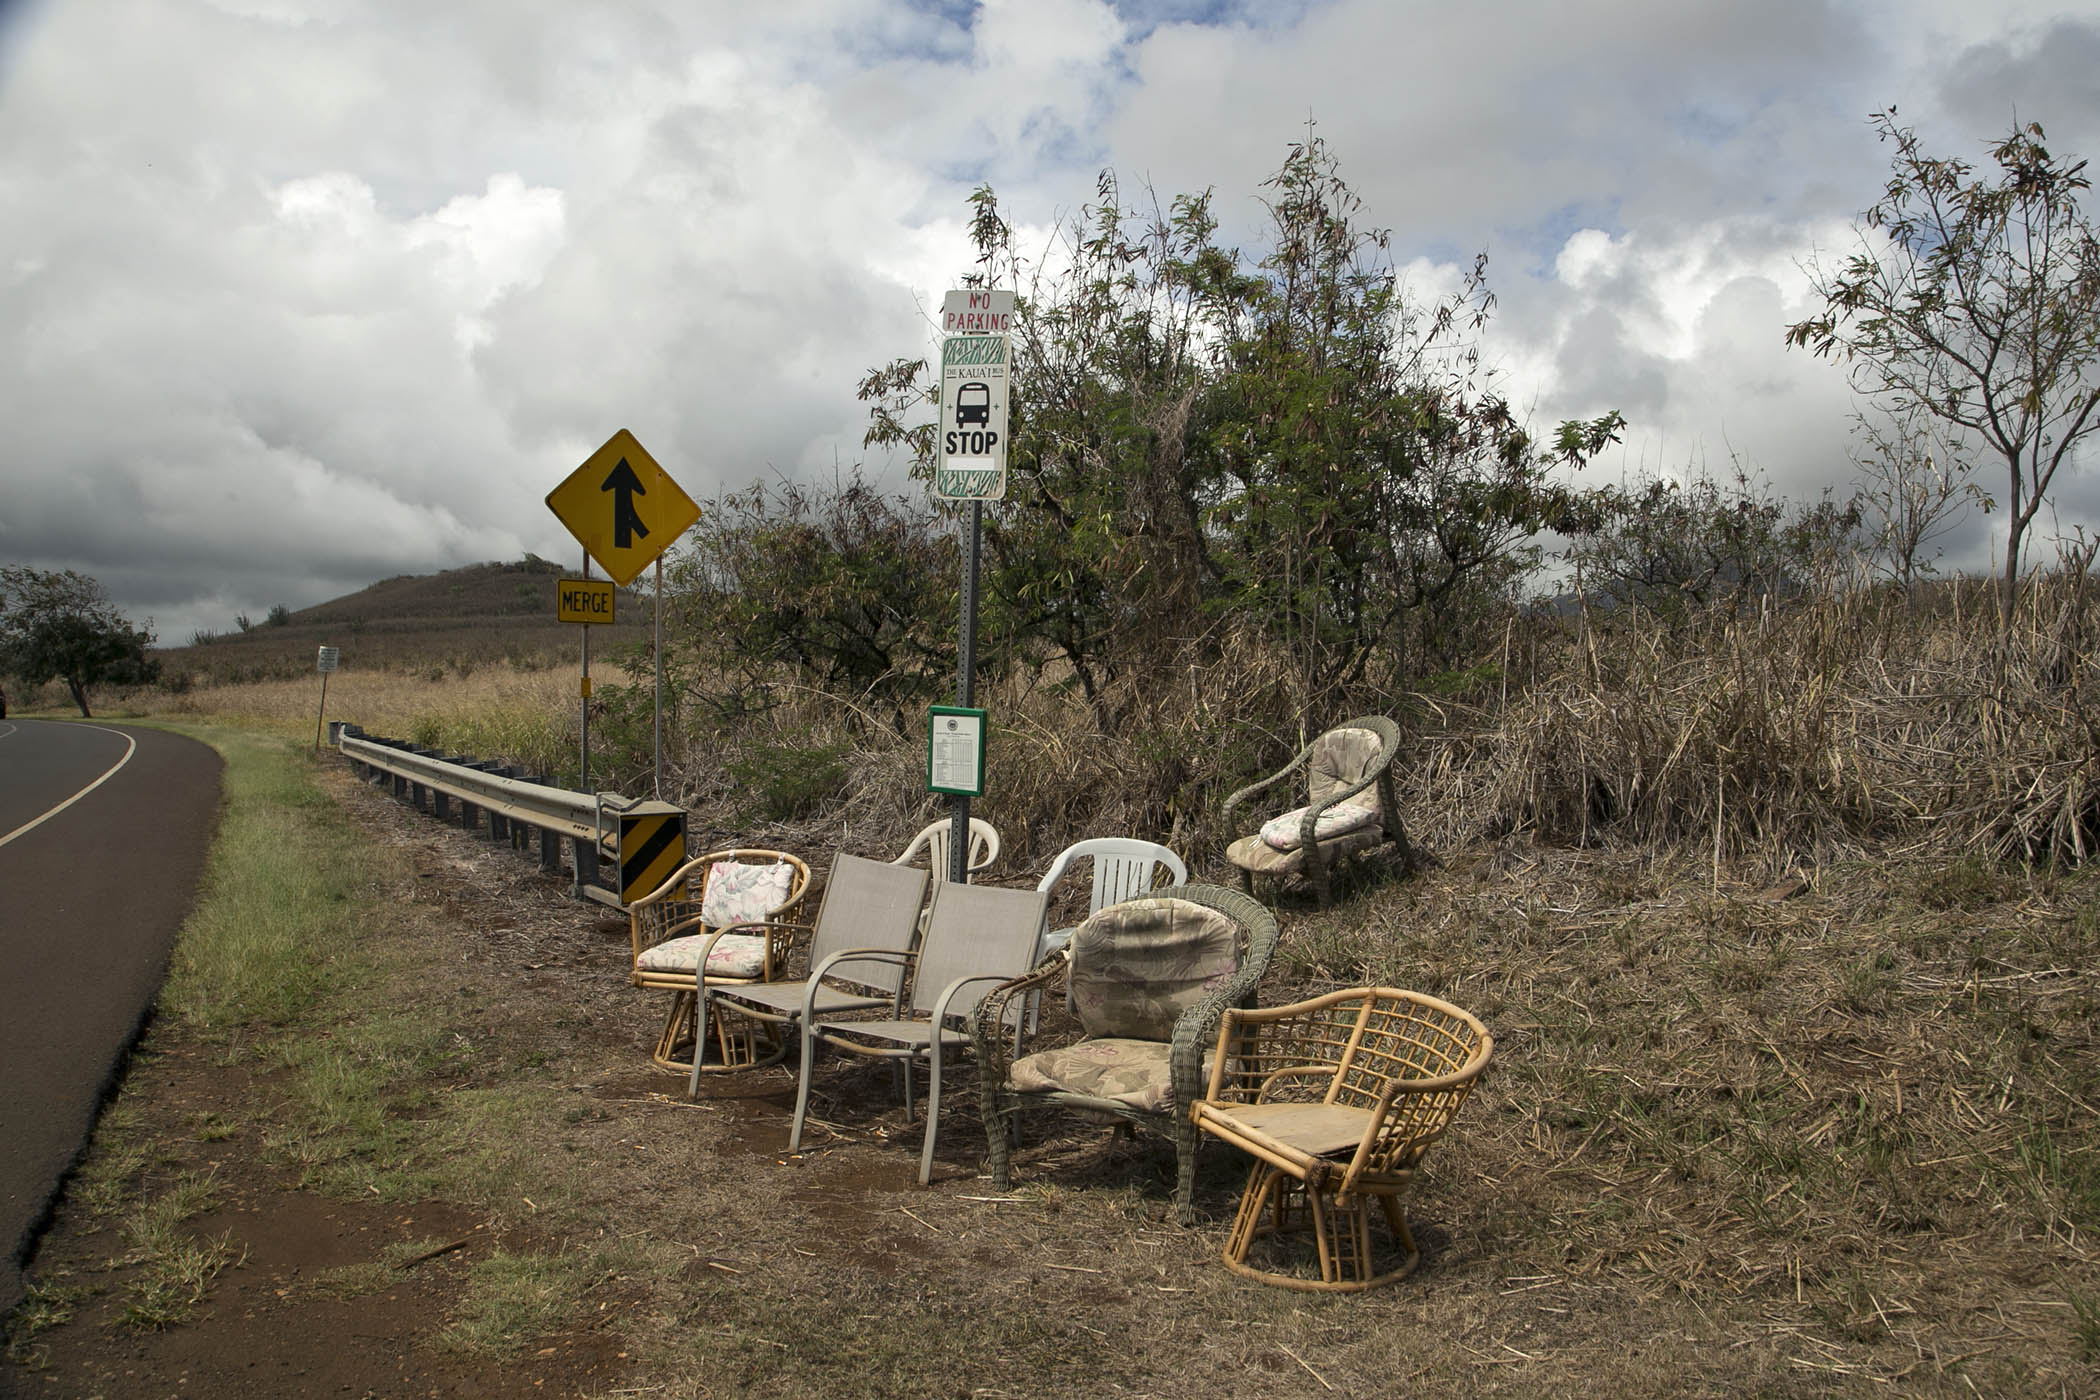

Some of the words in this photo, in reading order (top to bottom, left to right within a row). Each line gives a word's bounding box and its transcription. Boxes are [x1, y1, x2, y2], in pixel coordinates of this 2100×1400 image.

[969, 292, 990, 310] NO
[947, 313, 1009, 330] PARKING
[945, 431, 998, 455] STOP
[562, 591, 609, 613] MERGE
